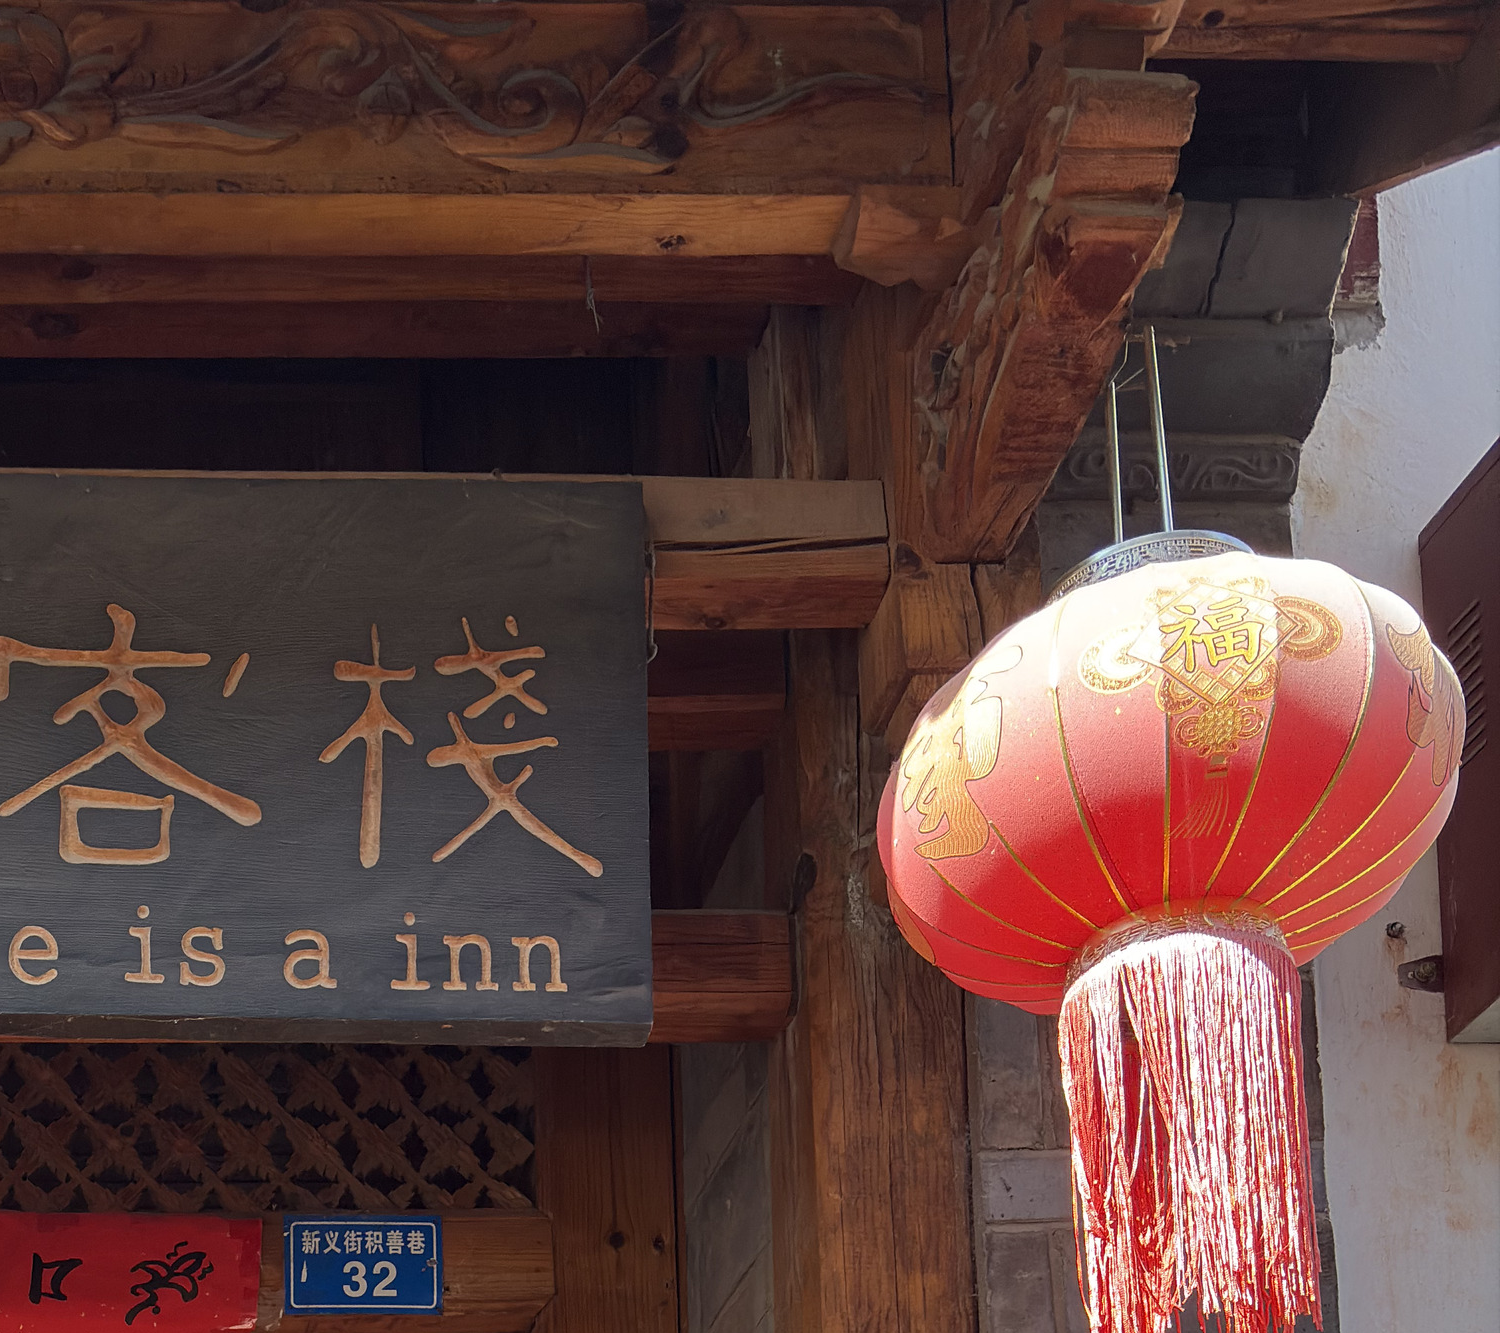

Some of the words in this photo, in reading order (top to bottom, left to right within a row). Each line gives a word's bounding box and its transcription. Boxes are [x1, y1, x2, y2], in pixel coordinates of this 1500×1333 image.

[1159, 595, 1267, 675] 福
[124, 905, 227, 987] is
[283, 928, 338, 989] a
[391, 911, 568, 993] inn
[301, 1230, 426, 1255] 新义街积善巷
[342, 1260, 398, 1298] 32
